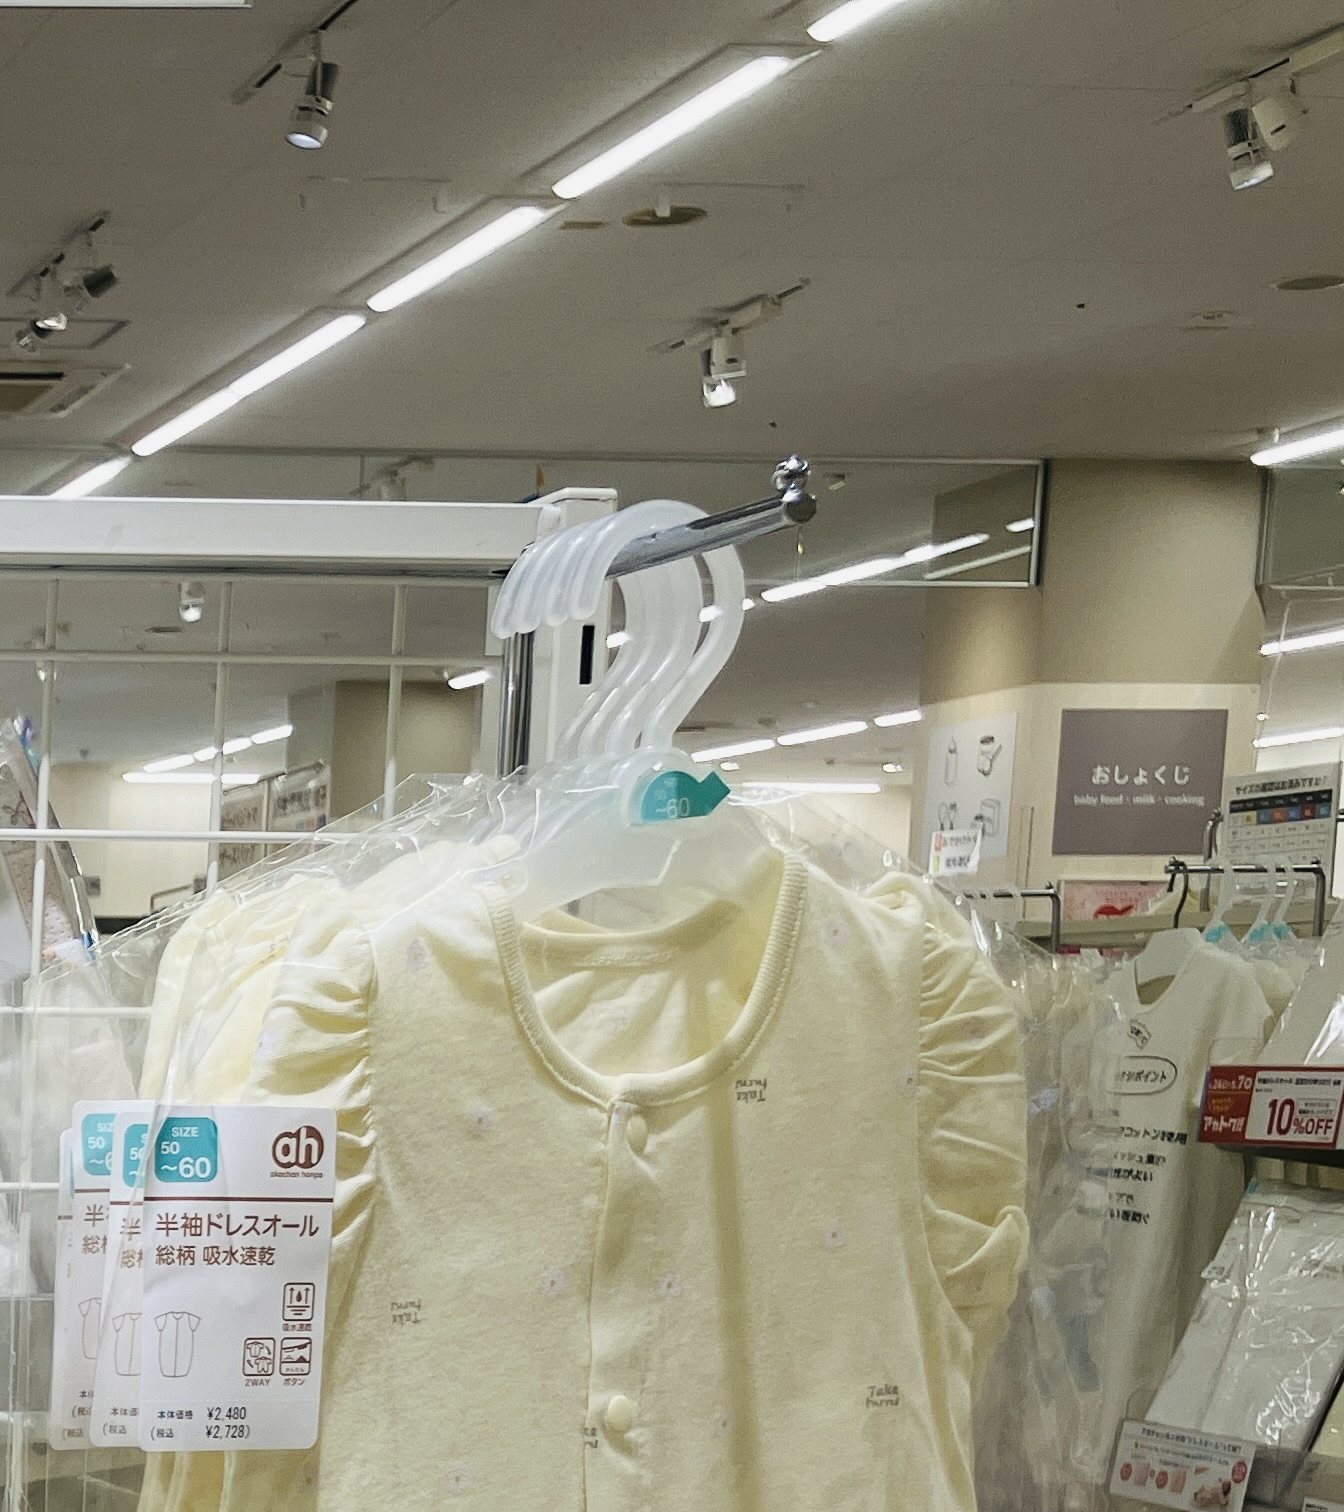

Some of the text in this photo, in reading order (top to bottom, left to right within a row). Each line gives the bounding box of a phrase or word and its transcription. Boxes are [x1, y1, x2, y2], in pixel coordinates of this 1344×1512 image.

[1090, 765, 1191, 787] おしょくじ
[96, 1122, 114, 1134] SIZ
[170, 1126, 200, 1139] SIZE
[87, 1136, 106, 1150] 50
[160, 1140, 181, 1156] 50
[270, 1125, 325, 1170] ah
[155, 1213, 320, 1238] 半袖ドレスオール
[155, 1246, 277, 1268] 総柄 吸水速乾
[244, 1378, 271, 1387] 2WAY
